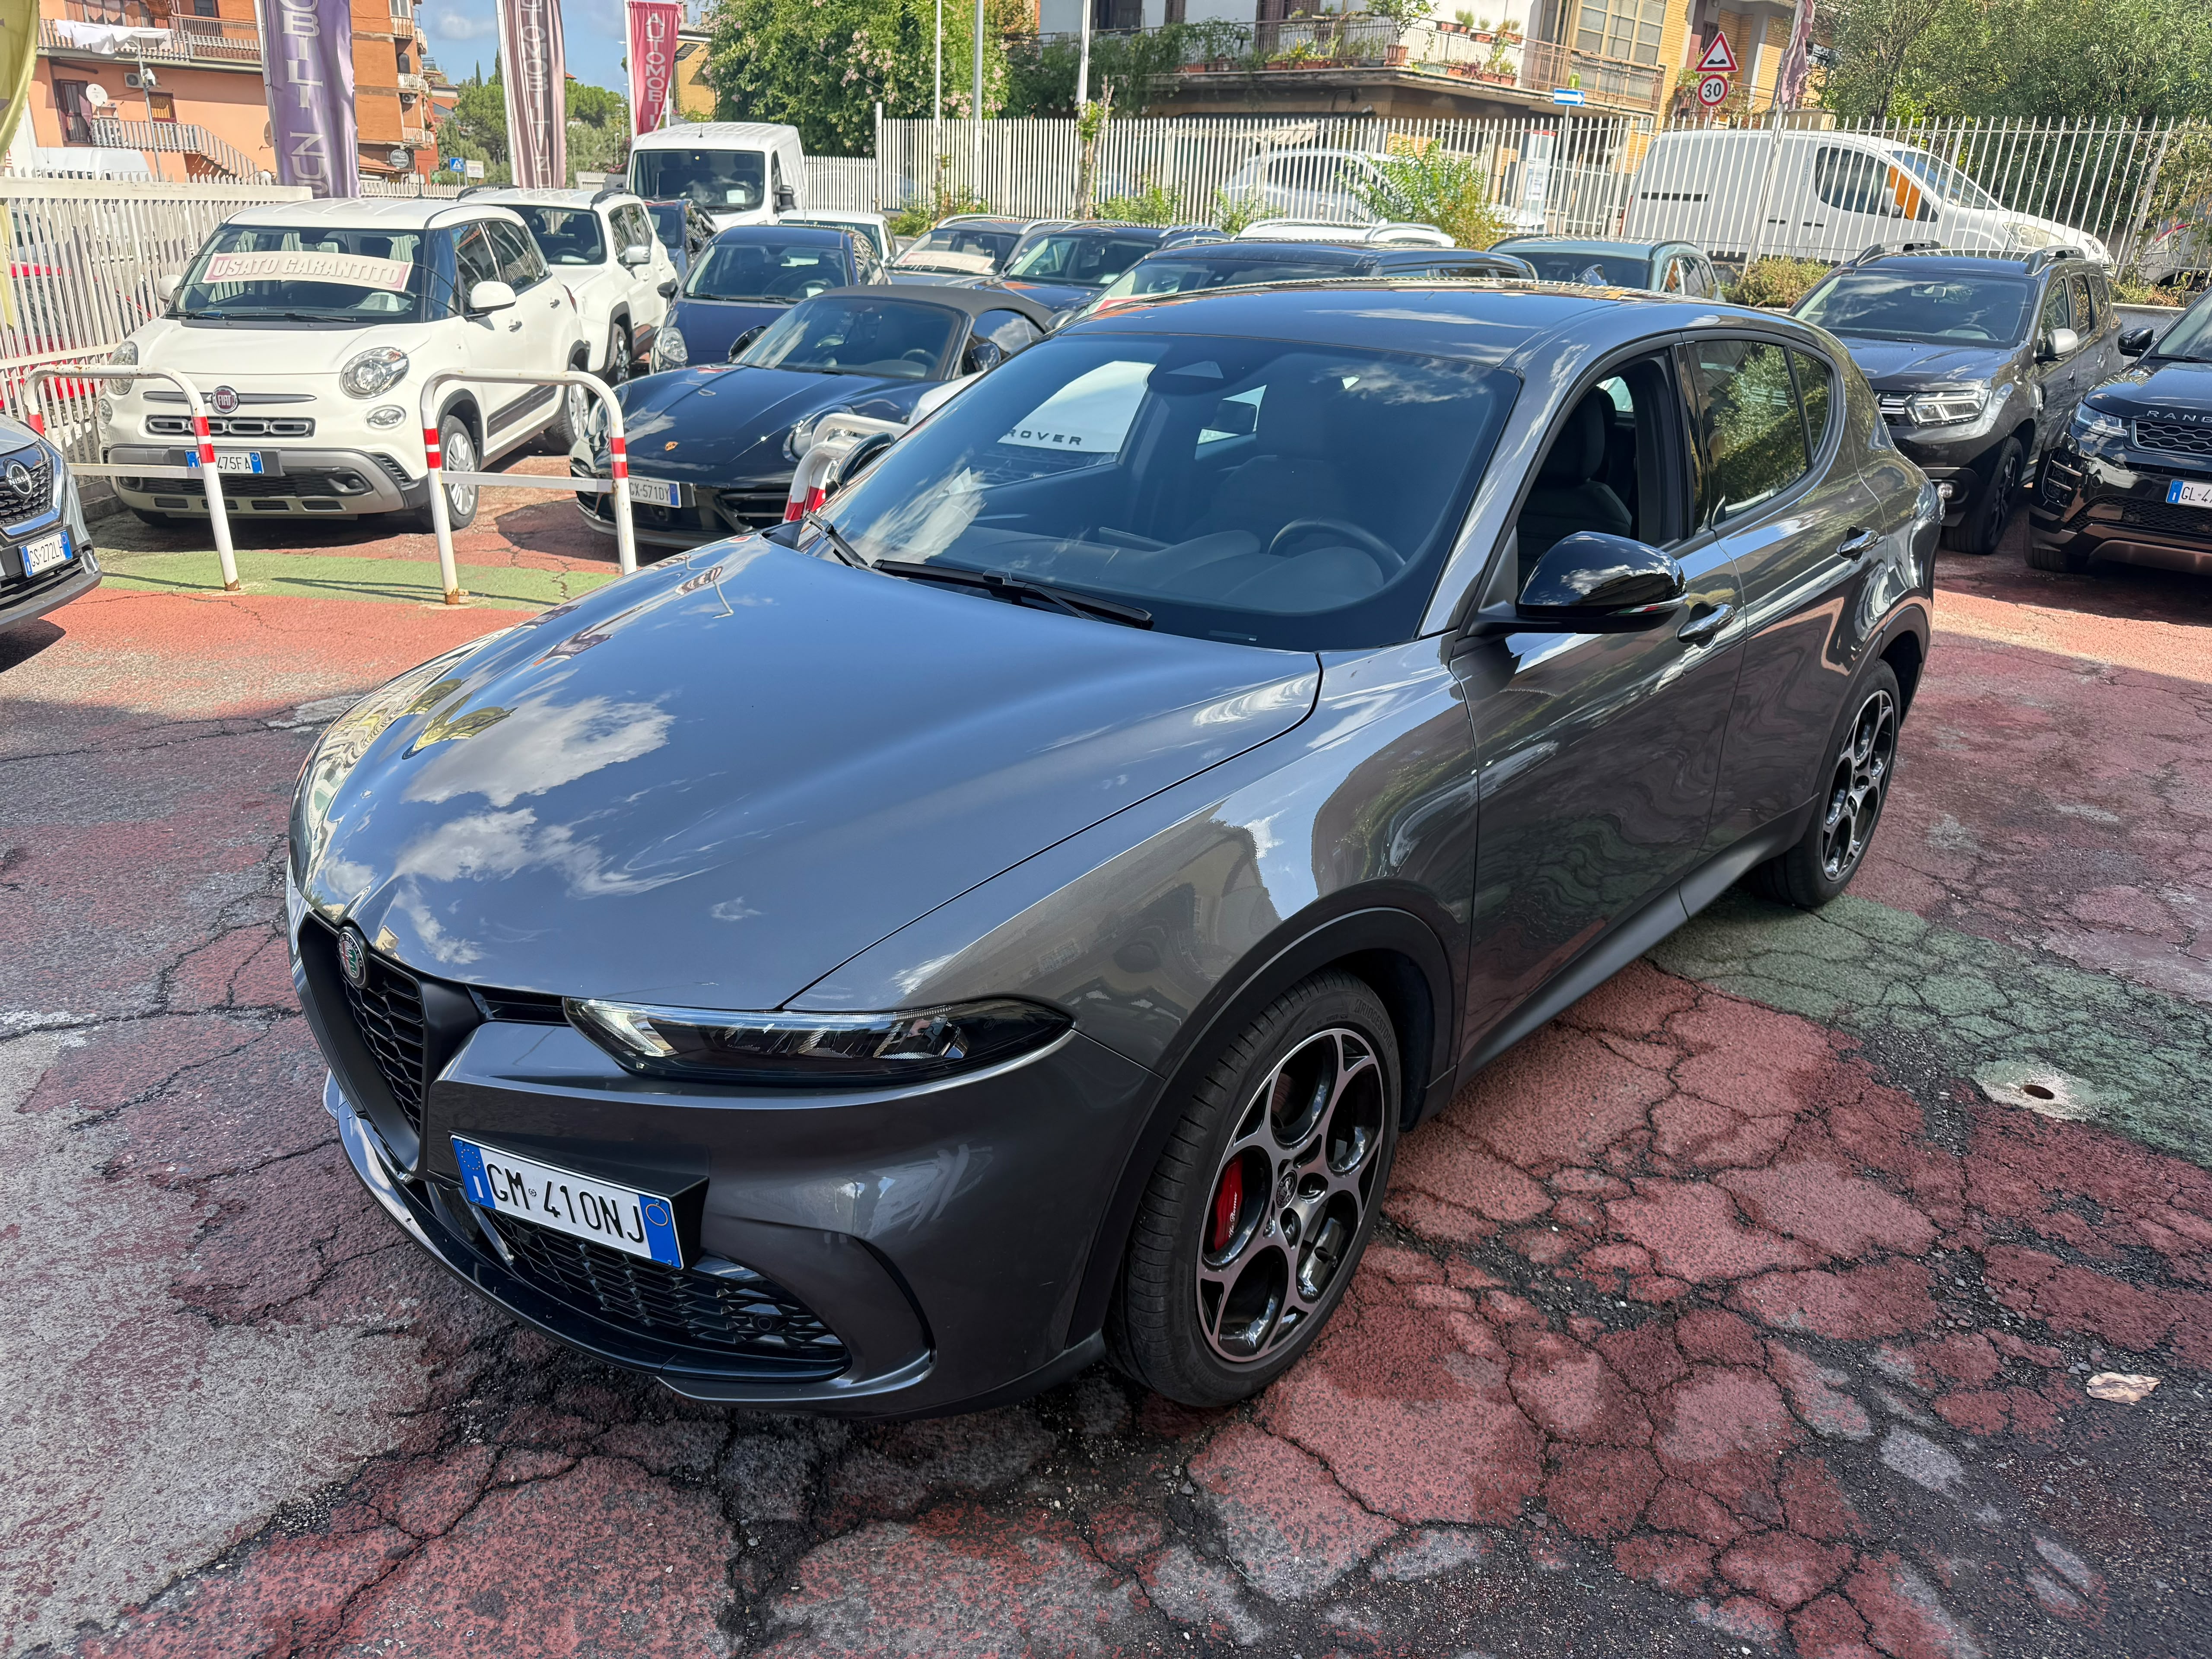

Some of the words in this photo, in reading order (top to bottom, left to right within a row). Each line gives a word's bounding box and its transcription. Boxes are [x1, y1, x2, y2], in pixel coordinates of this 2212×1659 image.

[1704, 83, 1721, 98] 30
[213, 258, 279, 276] USATO
[282, 258, 400, 284] GARANTITO
[218, 395, 231, 406] FIAT
[2147, 410, 2212, 423] RANG
[1006, 429, 1082, 445] ROVER
[2181, 486, 2196, 501] GL
[2201, 489, 2212, 503] 4
[346, 936, 362, 967] ROMEO
[486, 1163, 530, 1210] GM
[543, 1181, 644, 1243] 410NJ
